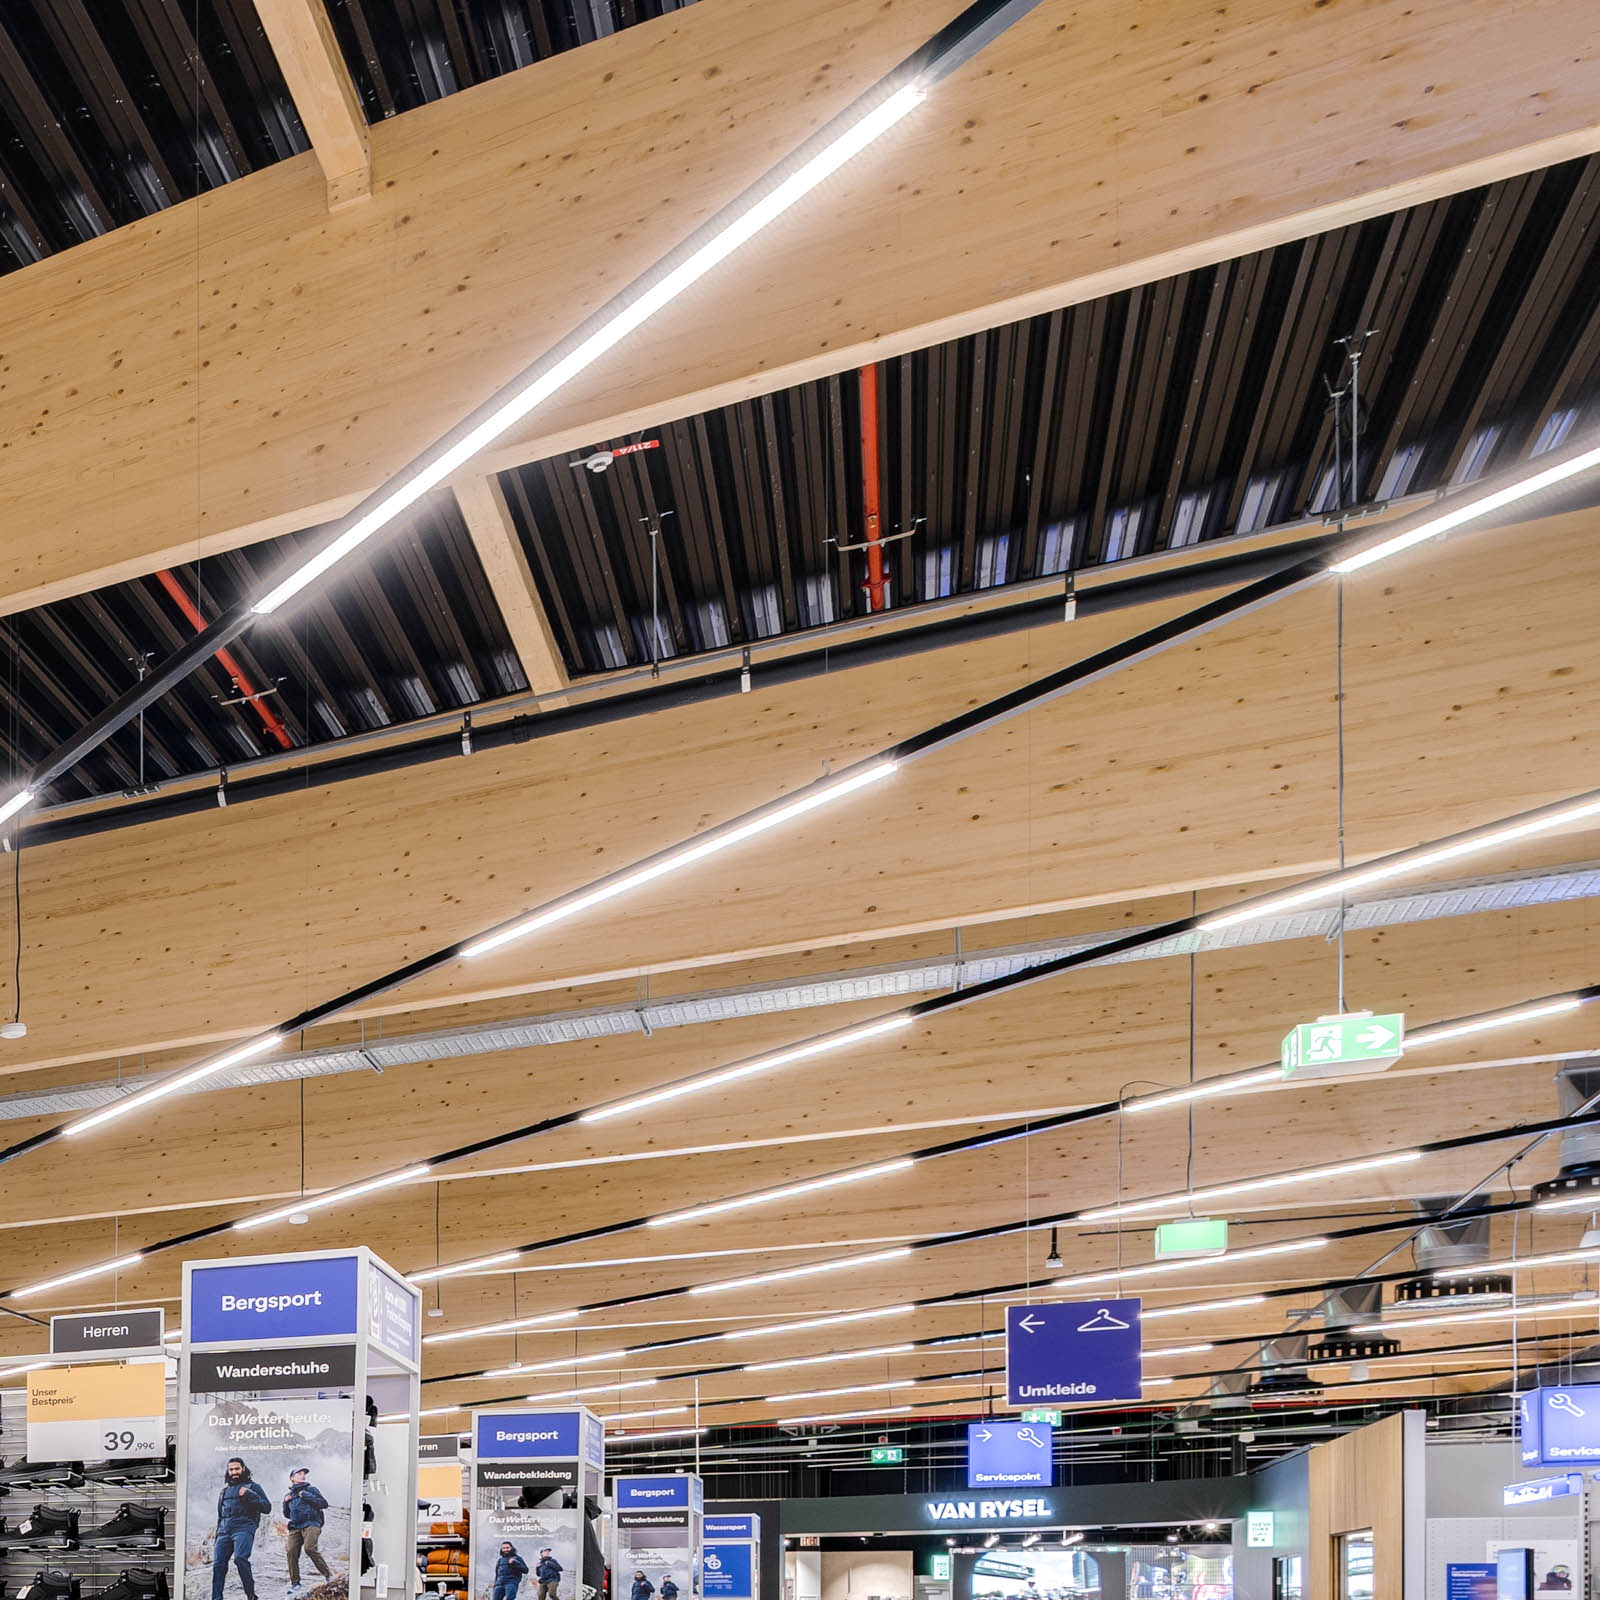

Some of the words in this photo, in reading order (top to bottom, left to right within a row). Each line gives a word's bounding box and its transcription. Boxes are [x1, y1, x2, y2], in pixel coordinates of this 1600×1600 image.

[221, 1290, 322, 1313] Bergsport
[83, 1325, 129, 1338] Herren
[216, 1361, 330, 1378] Wanderschuhe
[31, 1388, 58, 1397] Unser
[1018, 1382, 1096, 1397] Umkleide
[208, 1414, 232, 1427] Das
[235, 1412, 285, 1425] Wetter
[286, 1410, 332, 1424] heute:
[103, 1431, 155, 1452] 39,99€
[229, 1427, 294, 1442] sportlich.
[496, 1430, 559, 1442] Bergsport
[483, 1470, 572, 1480] Wanderbekleidung
[975, 1472, 1041, 1482] Servicepoint
[630, 1488, 675, 1498] Bergsport
[928, 1501, 976, 1520] VAN
[980, 1498, 1052, 1519] RYSEL
